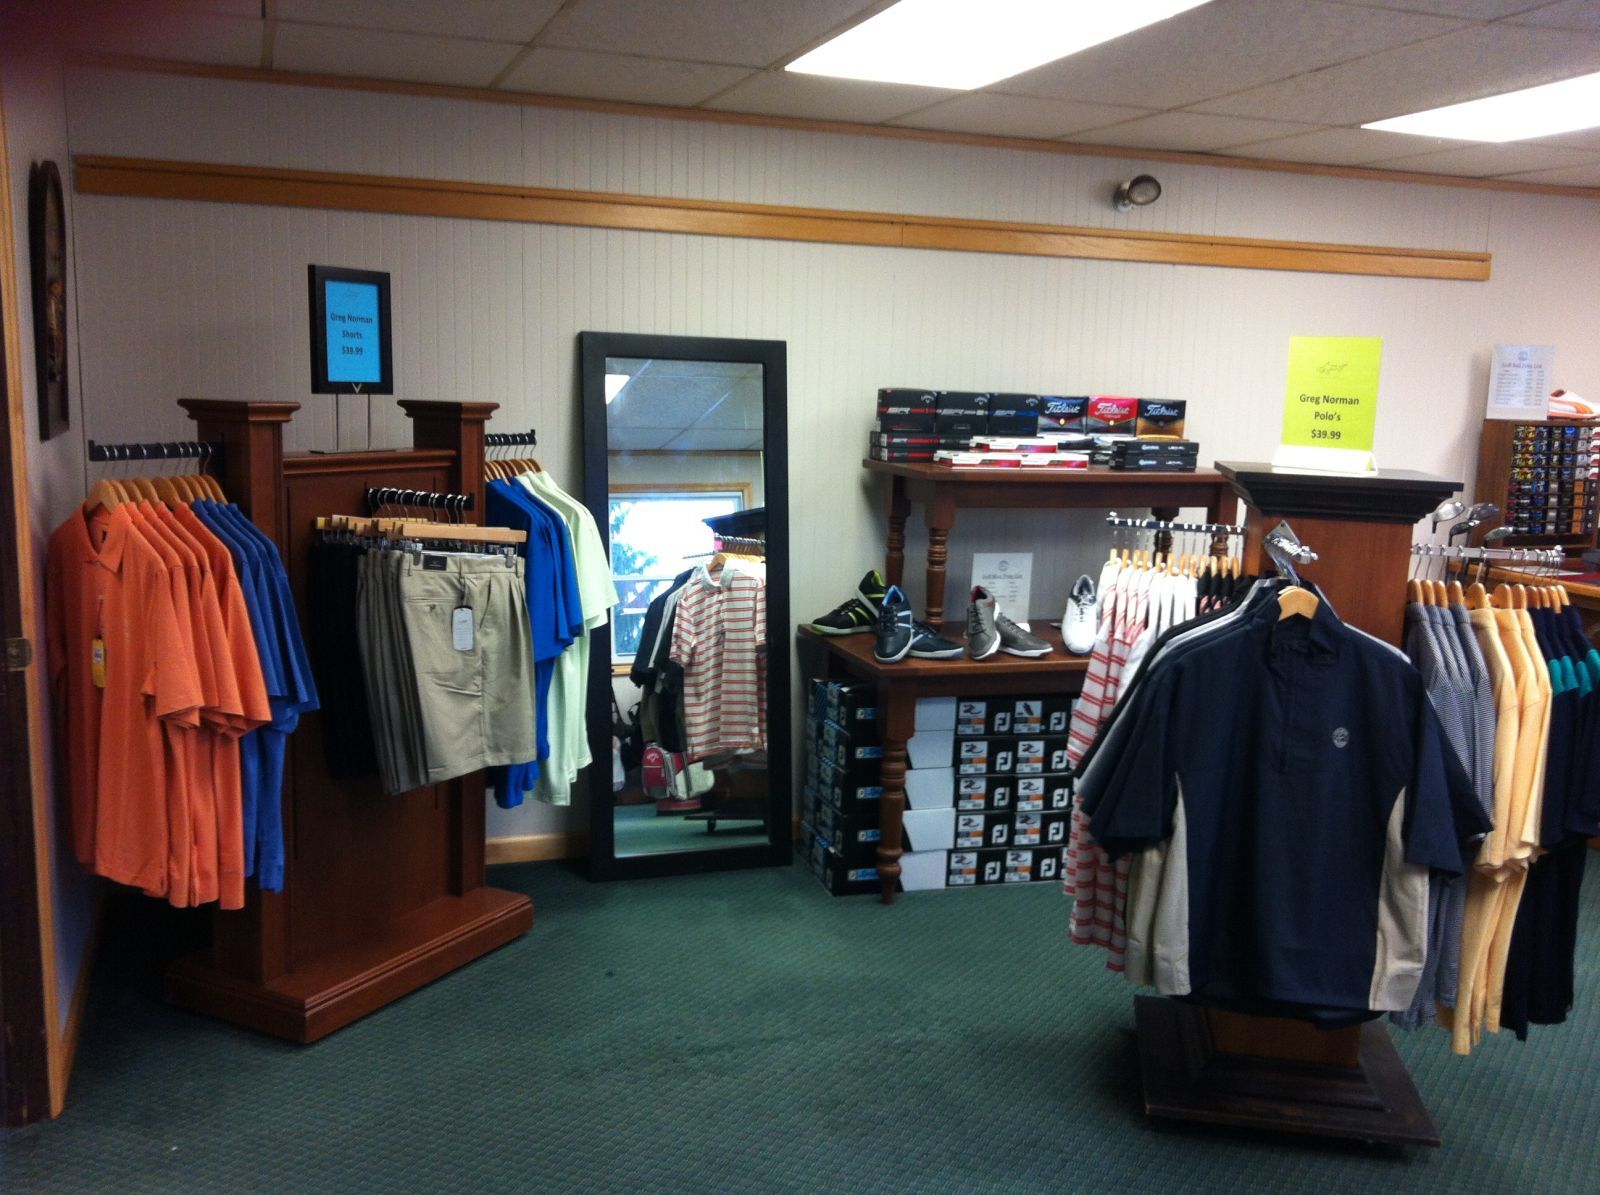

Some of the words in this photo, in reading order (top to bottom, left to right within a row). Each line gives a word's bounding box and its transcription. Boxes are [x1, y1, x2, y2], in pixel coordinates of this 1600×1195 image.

[330, 313, 346, 323] Greg
[347, 313, 373, 324] Norman
[342, 330, 363, 340] Shorts
[1299, 393, 1321, 405] Greg
[1322, 395, 1360, 406] Norman
[1044, 402, 1081, 415] Titleist
[1094, 402, 1130, 416] Titleist
[1144, 404, 1179, 417] Titleist
[1314, 411, 1342, 421] Polo's
[1311, 429, 1342, 440] $39.99
